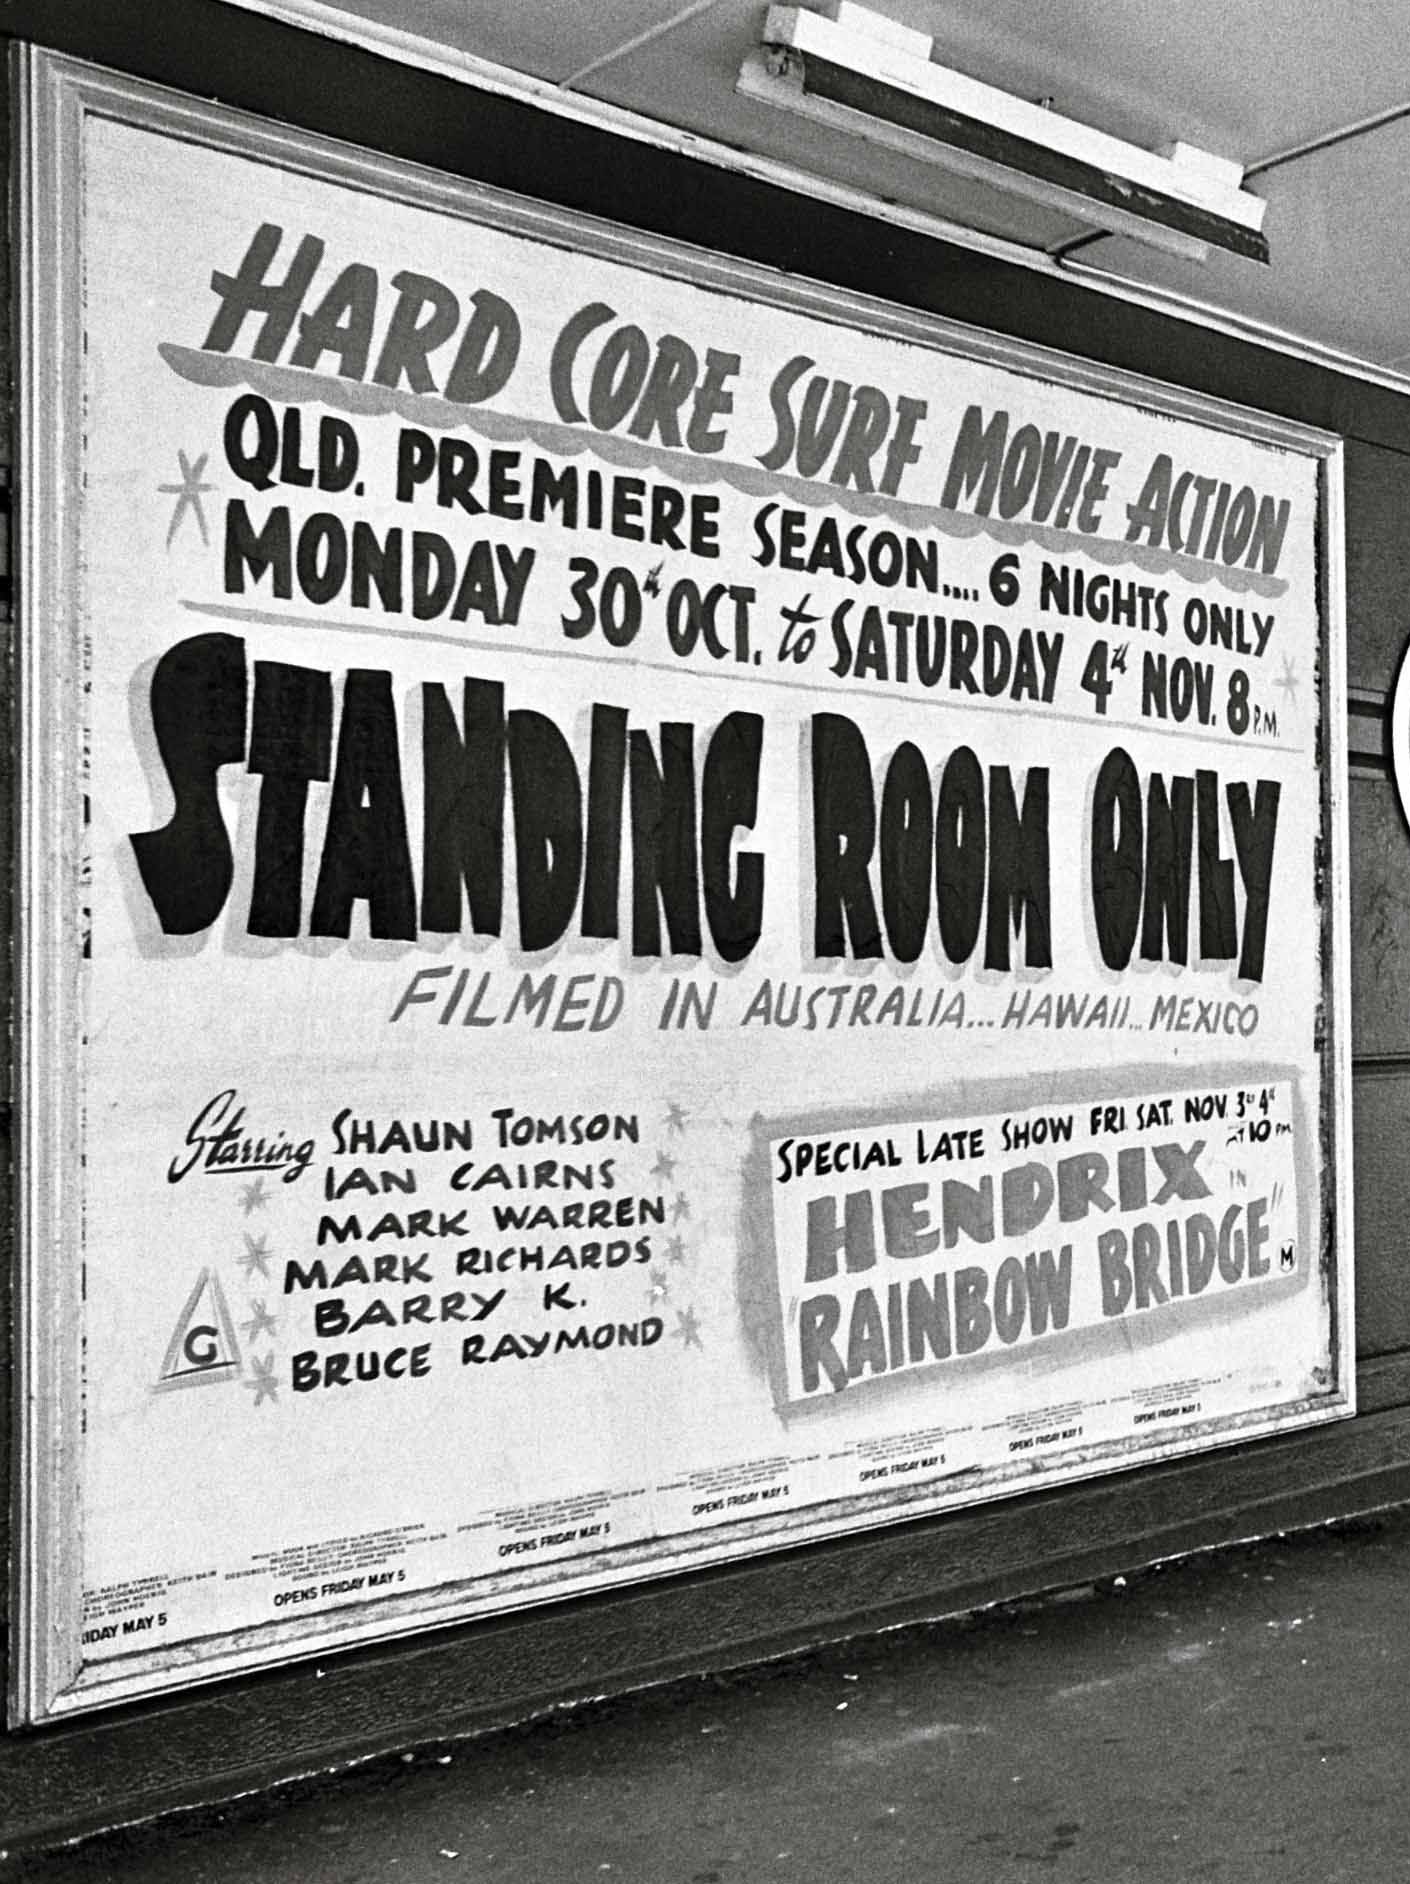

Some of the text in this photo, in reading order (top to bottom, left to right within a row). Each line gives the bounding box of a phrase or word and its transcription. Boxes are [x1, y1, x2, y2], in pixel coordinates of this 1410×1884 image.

[211, 223, 1290, 574] HARD CORE SURF MOVIE ACTION
[224, 394, 363, 496] QLD.
[397, 429, 720, 558] PREMIERE
[990, 554, 1019, 606] 6
[1041, 562, 1169, 636] NIGHTS
[1184, 599, 1274, 657] ONLY
[225, 499, 535, 625] MONDAY
[667, 579, 761, 665] OCT.
[778, 593, 826, 664] to
[830, 598, 1063, 704] SATURDAY
[129, 633, 1280, 982] STANDING ROOM ONLY
[389, 966, 623, 1032] FILMED
[659, 979, 717, 1030] IN
[1149, 995, 1258, 1036] MEXICO
[168, 1089, 638, 1183] Starring SHAUN TOMSON
[777, 1139, 901, 1183] SPECIAL
[918, 1129, 984, 1164] LATE
[1002, 1109, 1074, 1154] SHOW
[1250, 1120, 1271, 1142] 10
[325, 1159, 614, 1201] IAN CAIRNS
[317, 1197, 664, 1246] MARK WARREN
[804, 1140, 1246, 1283] HENDRIX IN
[284, 1236, 651, 1294] MARK RICHARDS
[315, 1282, 586, 1337] BARRY K.
[184, 1326, 219, 1365] G
[292, 1318, 663, 1392] BRUCE RAYMOND
[692, 1499, 725, 1516] OPENS
[498, 1522, 611, 1557] OPENS FRIDAY MAY 5
[273, 1586, 318, 1606] OPENS
[321, 1576, 365, 1598] FRIDAY
[368, 1571, 395, 1588] MAY
[397, 1570, 406, 1582] 5
[123, 1615, 154, 1634] MAY
[158, 1613, 168, 1626] 5
